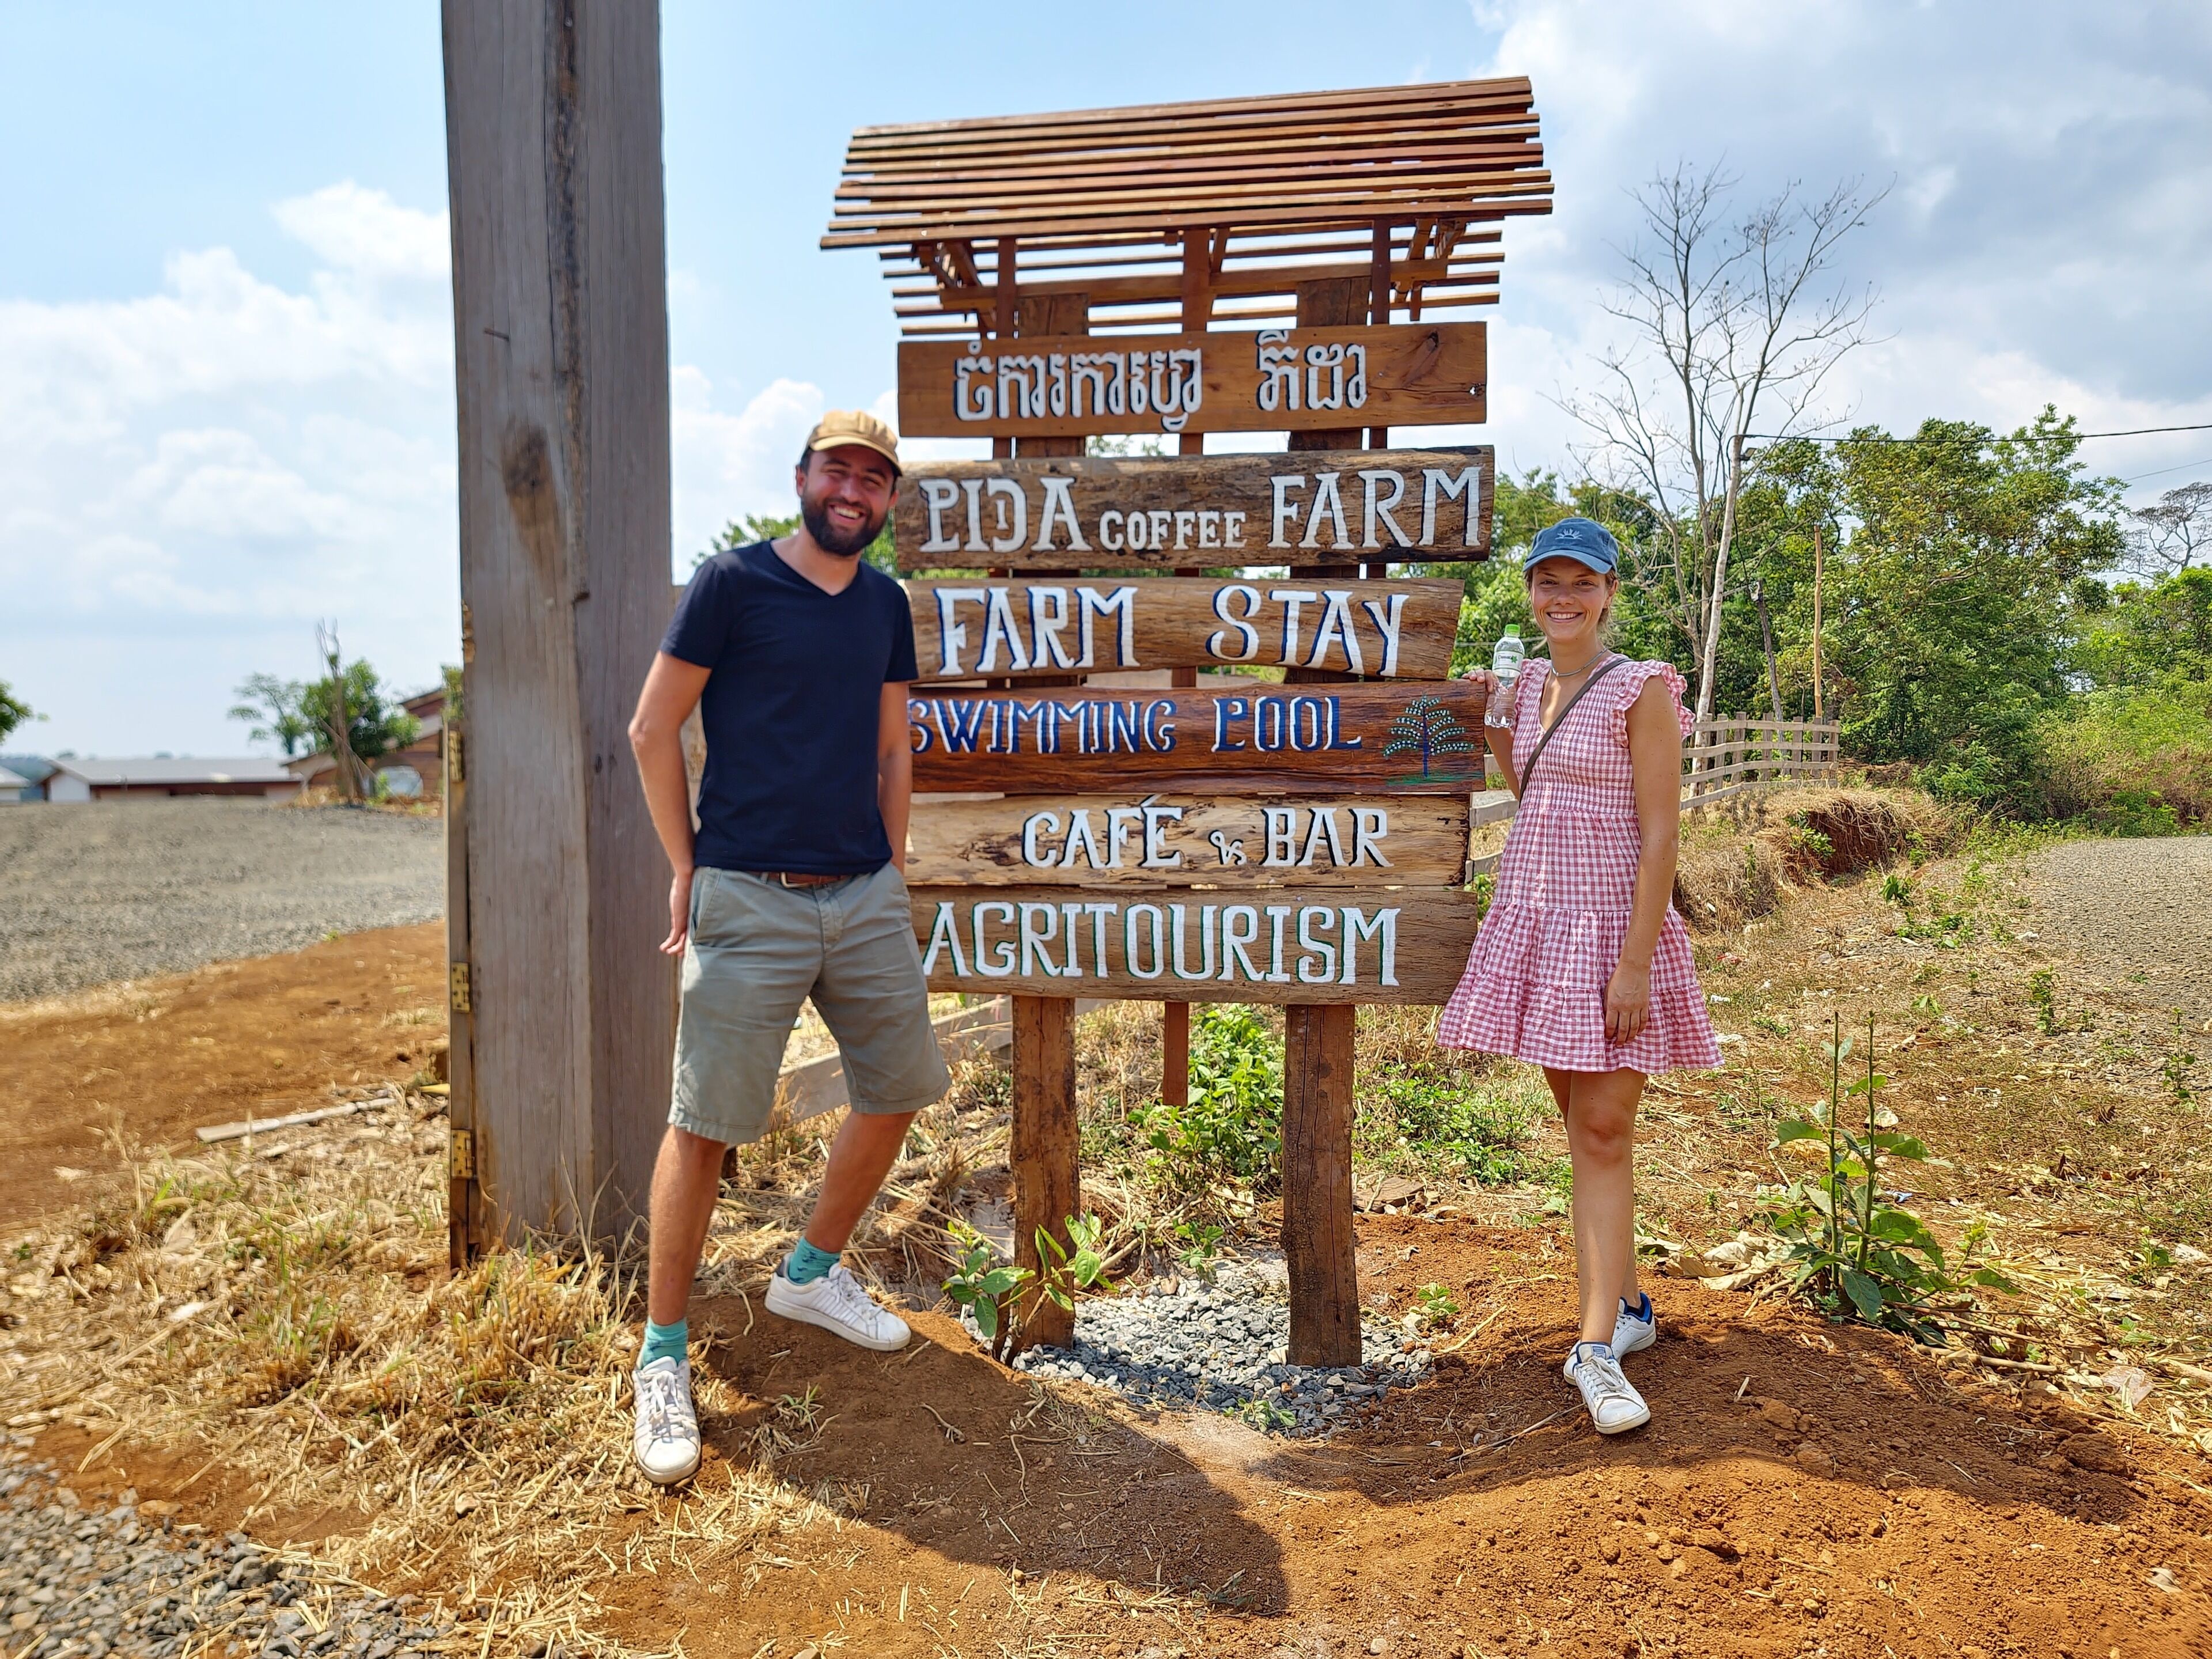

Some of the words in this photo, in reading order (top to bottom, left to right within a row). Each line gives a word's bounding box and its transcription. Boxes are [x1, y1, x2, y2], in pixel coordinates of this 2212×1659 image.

[919, 476, 1093, 552] PIDA
[1099, 510, 1246, 550] COFFEE
[1267, 465, 1483, 550] FARM
[933, 586, 1141, 675] FARM
[1206, 585, 1409, 677] STAY
[907, 698, 1176, 753] SWIMMING
[1211, 696, 1362, 753] POOL
[1022, 794, 1183, 868] CAFÉ
[1207, 830, 1247, 865] &
[1260, 807, 1394, 868] BAR
[923, 902, 1401, 986] AGRITOURISM
